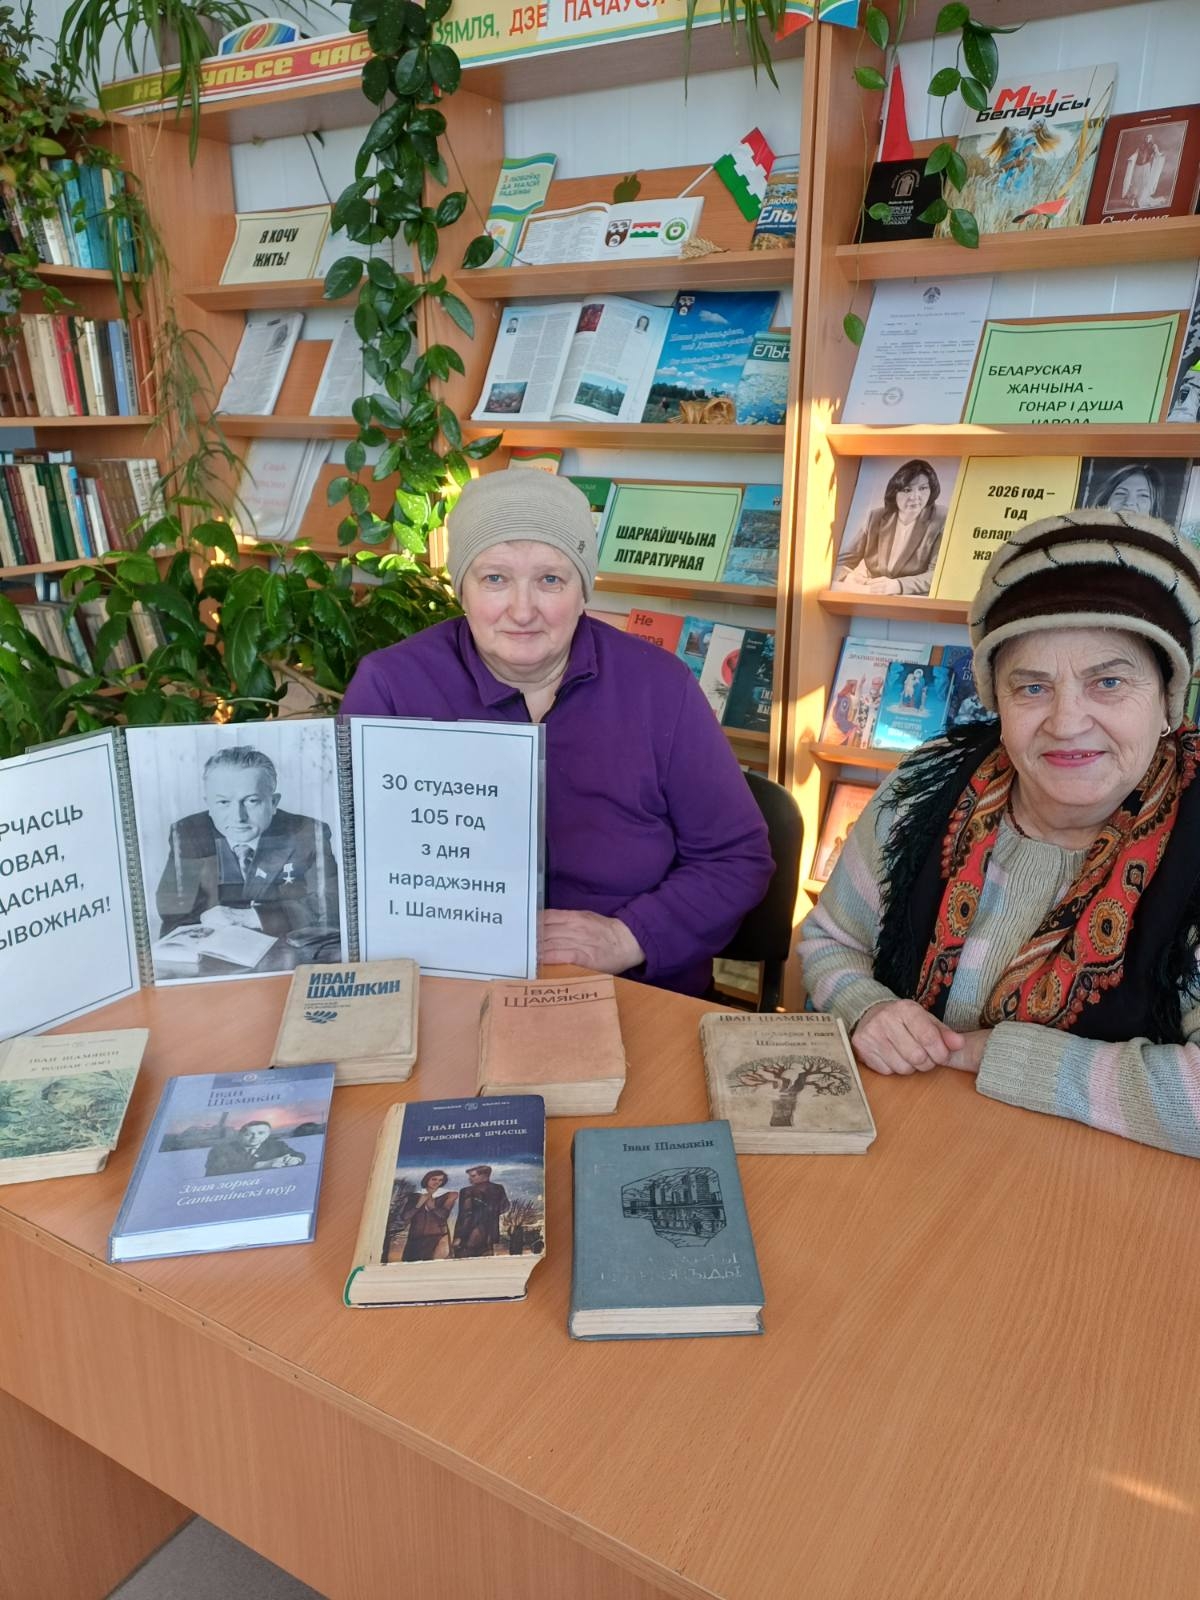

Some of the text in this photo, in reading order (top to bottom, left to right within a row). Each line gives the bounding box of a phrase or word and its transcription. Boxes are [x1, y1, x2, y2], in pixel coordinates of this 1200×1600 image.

[432, 0, 665, 45] ЗЯМЛЯ, ДЗЕ ПАЧА
[993, 85, 1058, 113] Мы
[259, 228, 299, 244] Я ХОЧУ
[252, 251, 290, 267] ЖИТЬ!
[988, 364, 1082, 377] БЕЛАРУСКАЯ
[1006, 382, 1084, 395] ЖАНЧЫНА
[1018, 401, 1067, 412] ГОНАР
[1077, 400, 1124, 413] ДУША
[987, 485, 1020, 498] 2026
[1021, 488, 1044, 500] год
[1004, 507, 1028, 521] Год
[615, 525, 717, 548] ШАРКАЎШЧЫНА
[972, 526, 1016, 541] белар
[614, 548, 705, 571] ЛІТАРАТУРНАЯ
[973, 550, 996, 561] жа
[634, 613, 654, 627] Не
[382, 774, 499, 798] 30 студзеня
[410, 807, 486, 831] 105 год
[421, 843, 470, 859] з дня
[0, 844, 65, 877] ОВАЯ,
[389, 872, 506, 894] нараджэння
[389, 899, 503, 925] І. Шамякіна
[309, 971, 356, 985] ИВАН
[306, 979, 400, 999] ШАМЯКИН
[504, 991, 598, 1008] ШАМЯКІН
[427, 1119, 519, 1132] ІВАН ШАМЯКІН
[417, 1128, 528, 1142] ТРЫВОЖНАЕ ШЧАСЦЕ
[622, 1139, 714, 1152] Іван Шамякін
